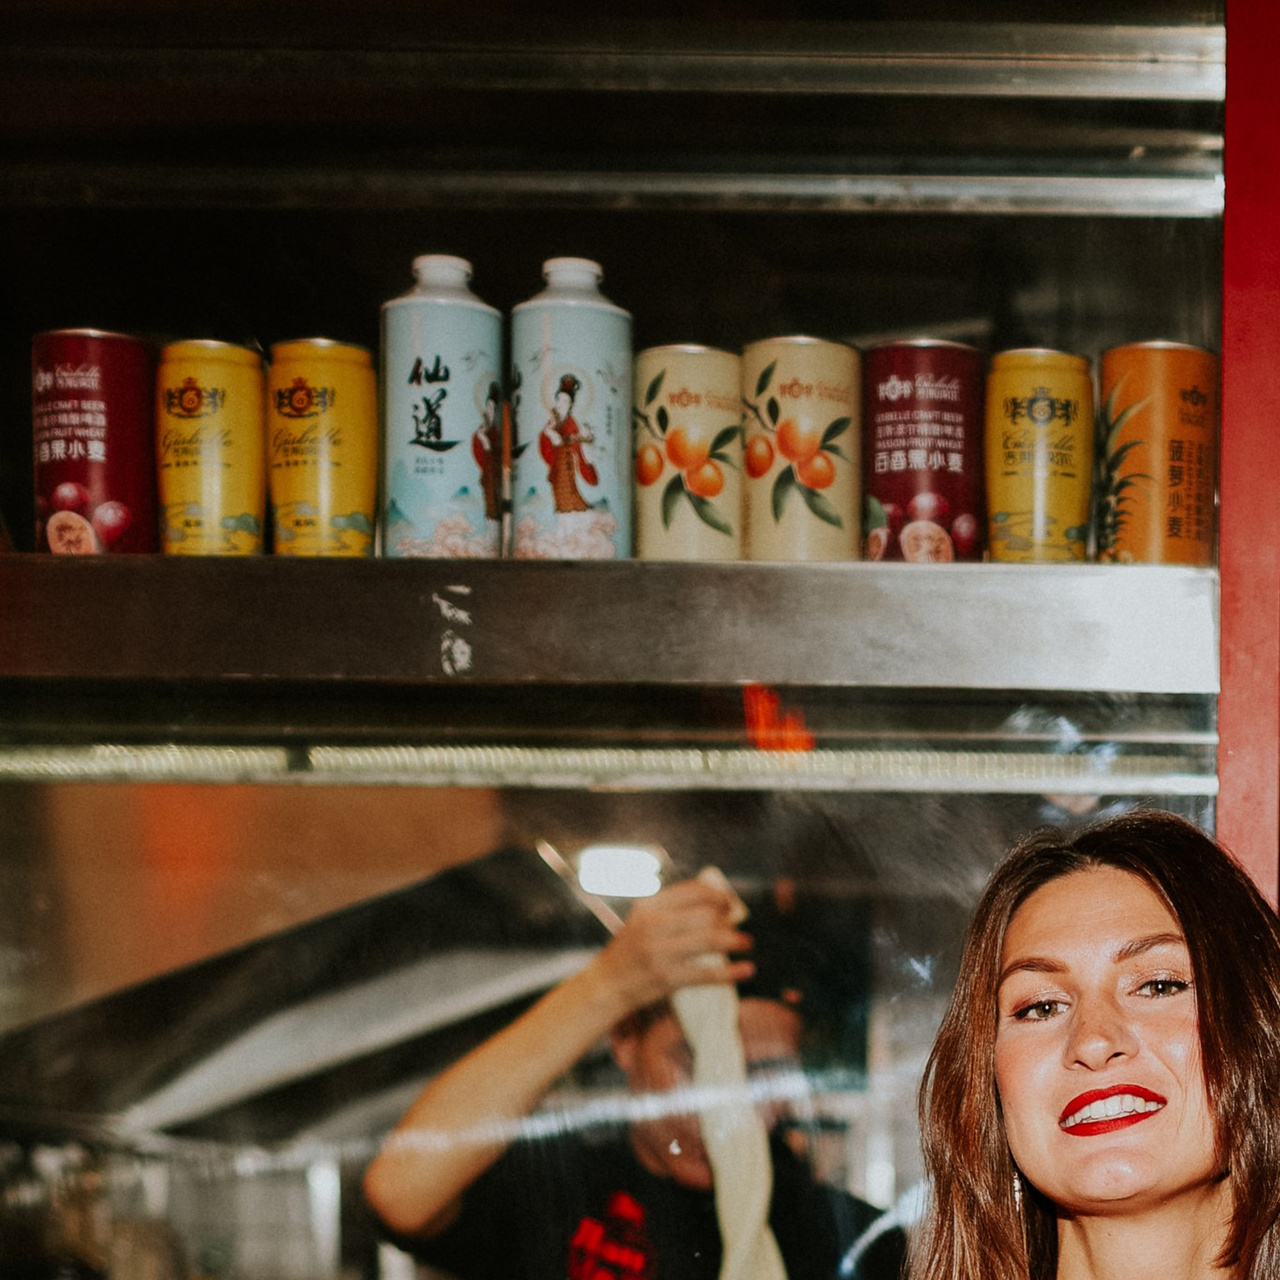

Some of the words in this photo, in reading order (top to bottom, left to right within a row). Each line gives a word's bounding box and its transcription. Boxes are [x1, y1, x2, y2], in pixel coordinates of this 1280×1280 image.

[407, 354, 462, 452] 仙道
[34, 439, 106, 463] 香果小麦
[874, 448, 964, 473] 百香果小麦
